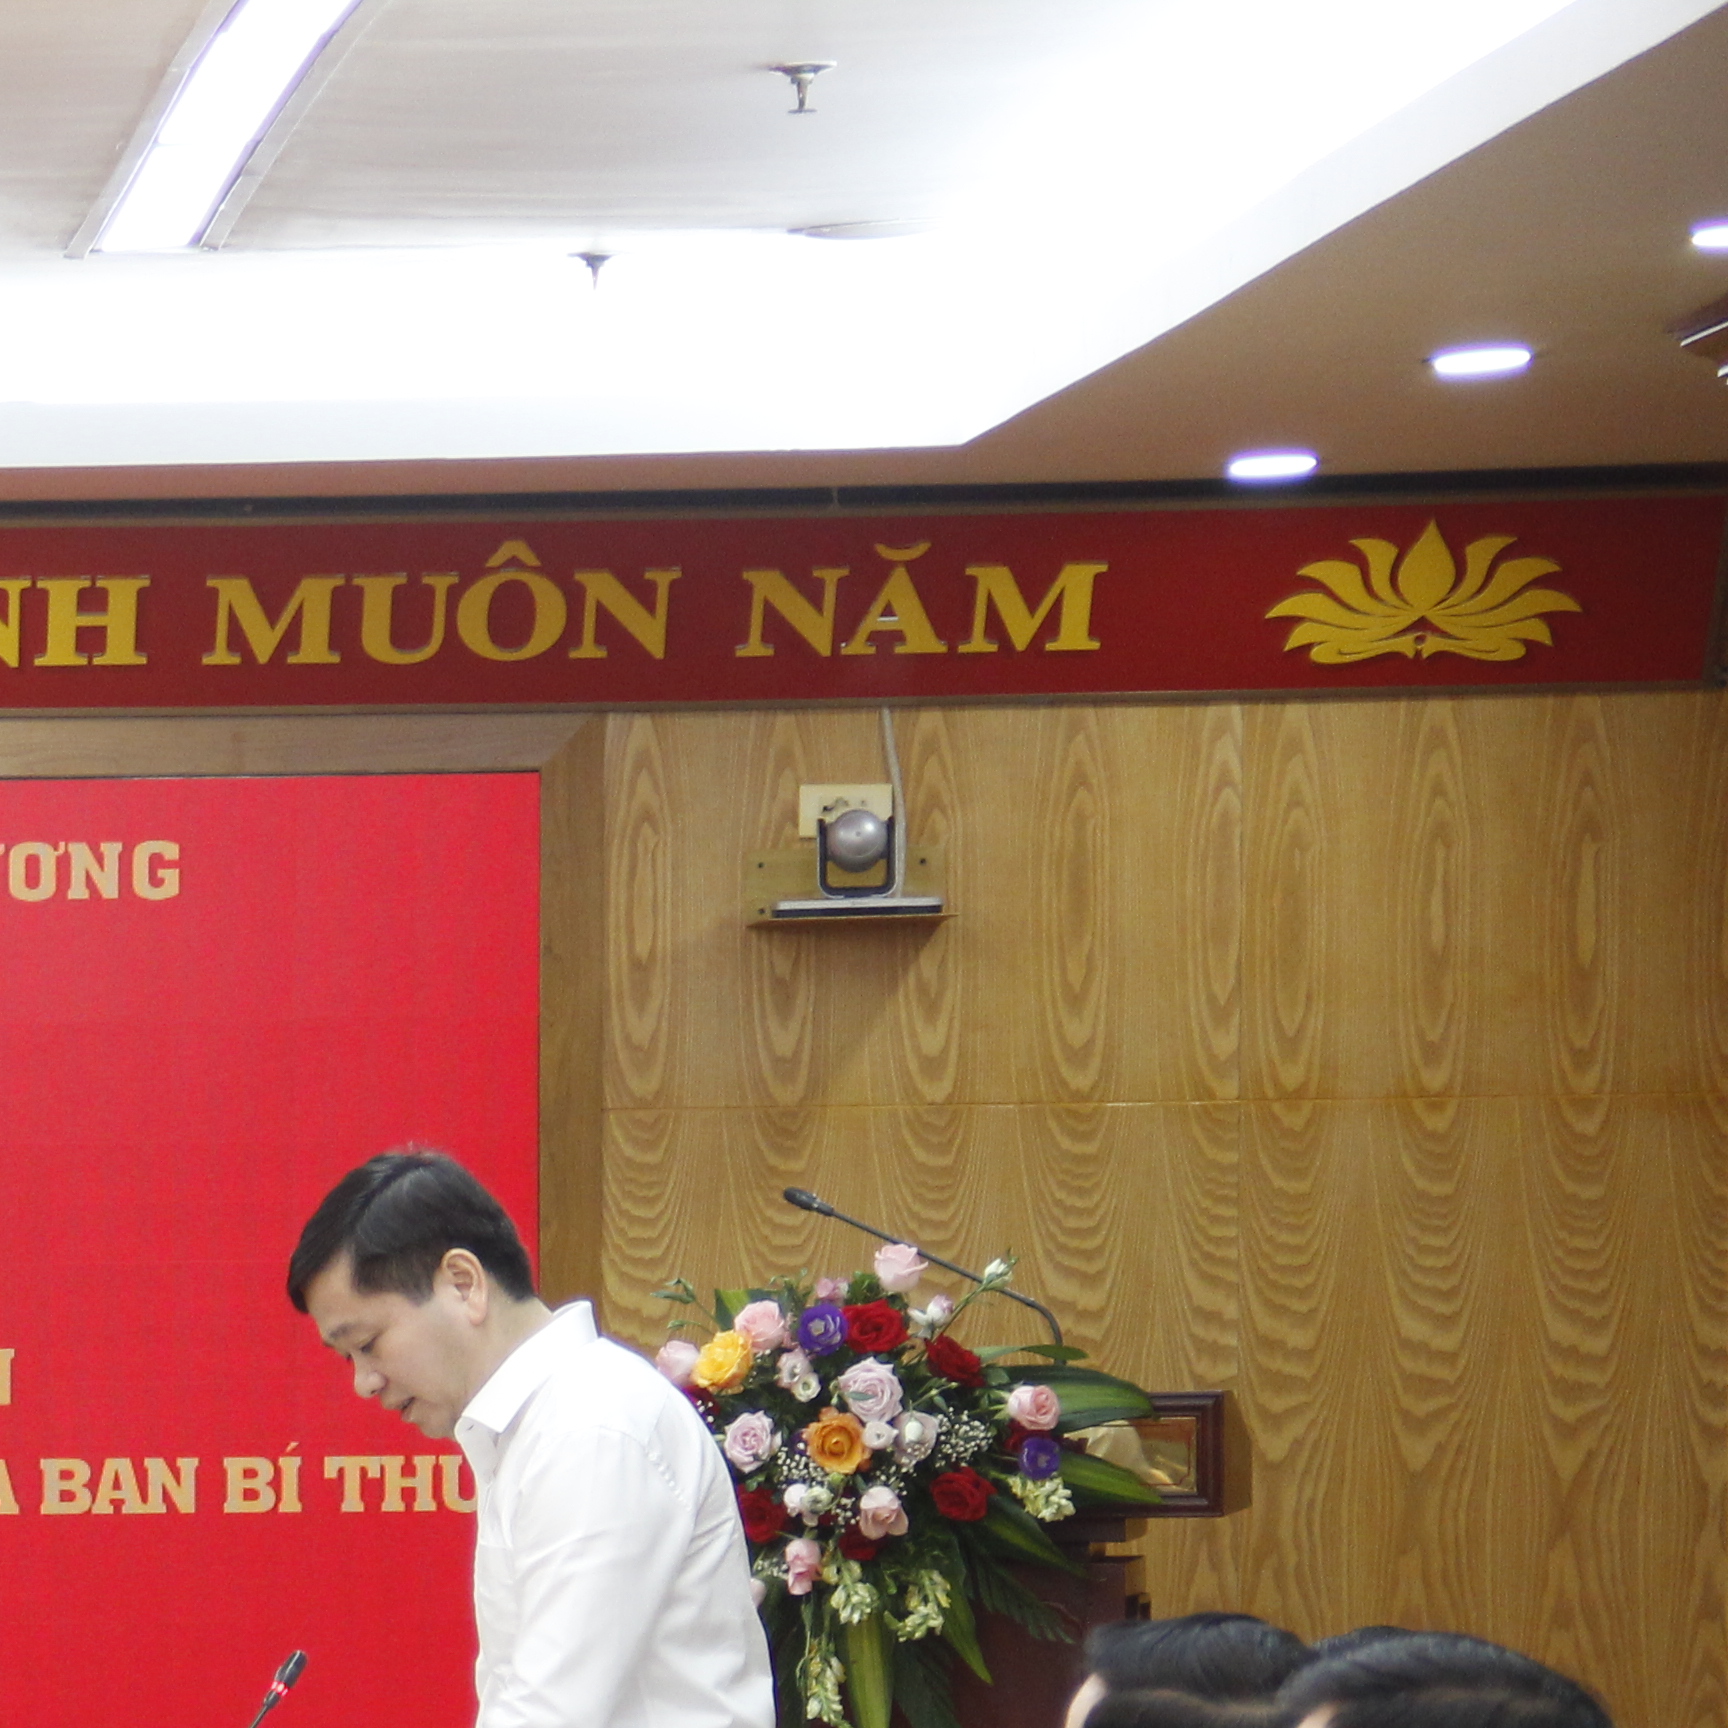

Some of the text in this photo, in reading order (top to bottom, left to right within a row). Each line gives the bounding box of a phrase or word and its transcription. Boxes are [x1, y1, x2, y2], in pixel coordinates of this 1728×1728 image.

[201, 540, 683, 666] MUÔN
[735, 542, 1108, 658] NĂM
[39, 1457, 200, 1515] BAN
[223, 1441, 303, 1514] BÍ
